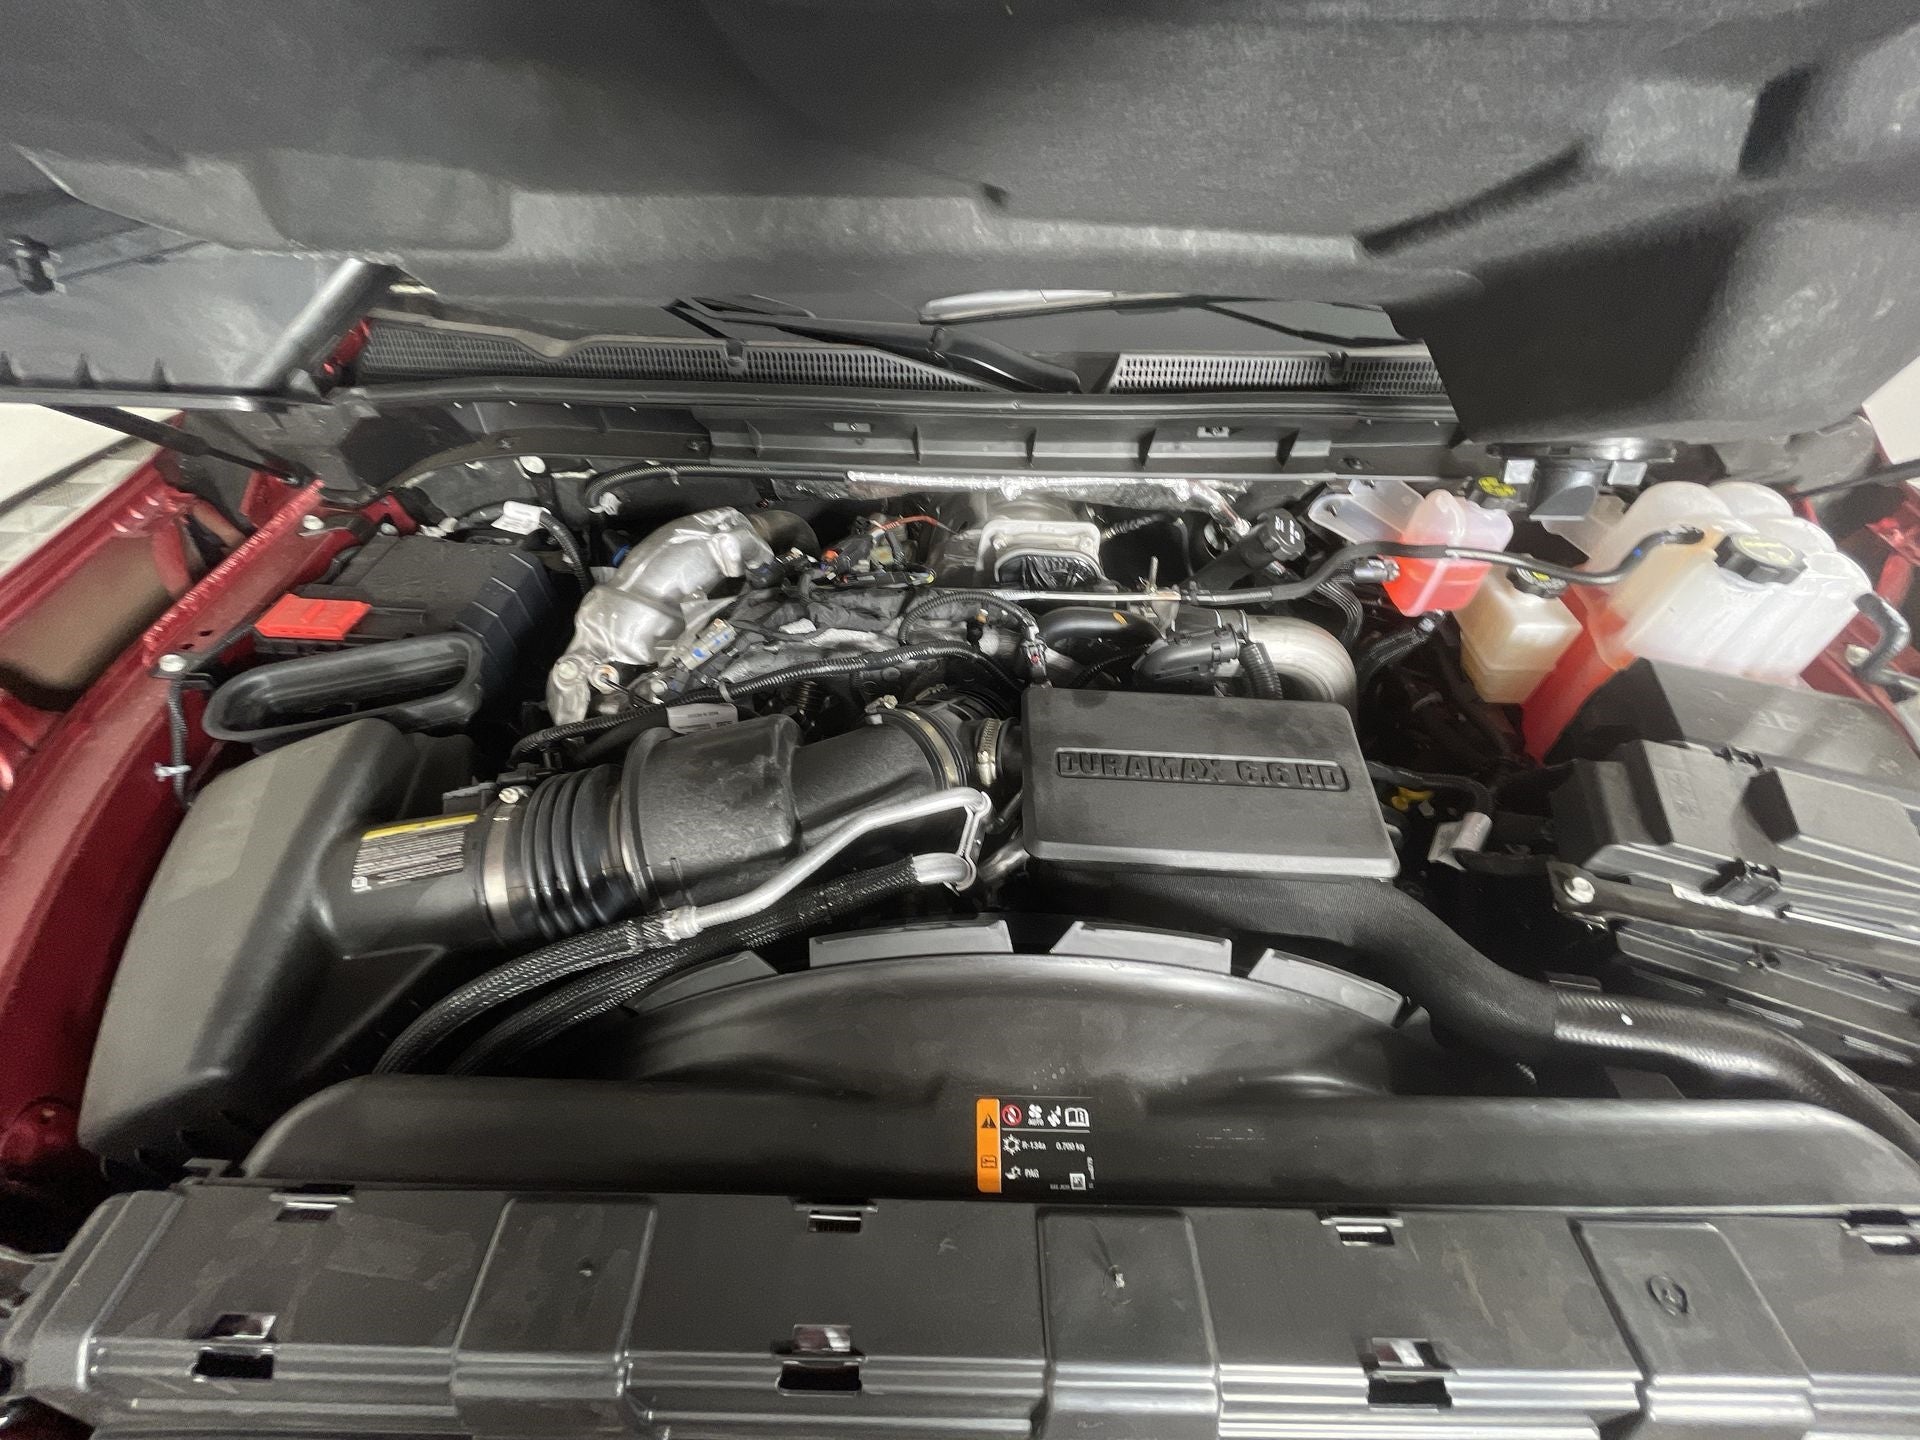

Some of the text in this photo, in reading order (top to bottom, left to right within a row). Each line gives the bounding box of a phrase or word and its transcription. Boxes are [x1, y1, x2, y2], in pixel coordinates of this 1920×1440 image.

[1059, 751, 1345, 788] DURAMAX 6.6 HD
